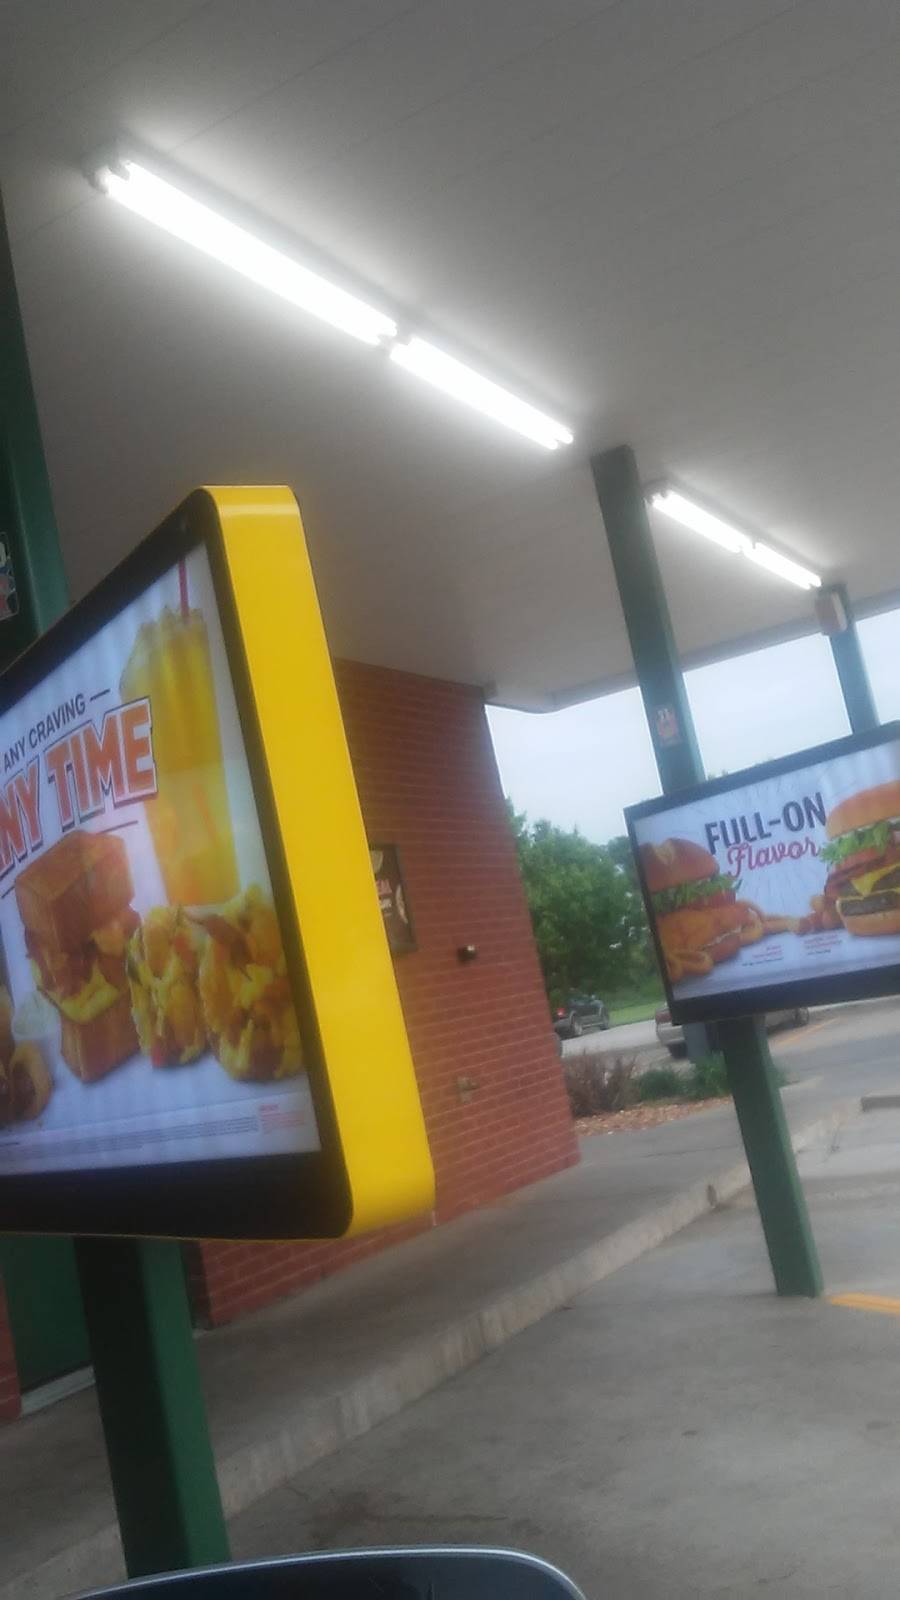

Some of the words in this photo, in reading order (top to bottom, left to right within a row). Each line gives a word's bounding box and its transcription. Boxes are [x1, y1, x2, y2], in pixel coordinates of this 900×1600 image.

[3, 736, 26, 772] ANY
[28, 693, 86, 750] CRAVING
[0, 754, 43, 880] NY
[44, 697, 158, 833] TIME
[704, 792, 827, 854] FULL-ON
[726, 836, 819, 877] Flavor
